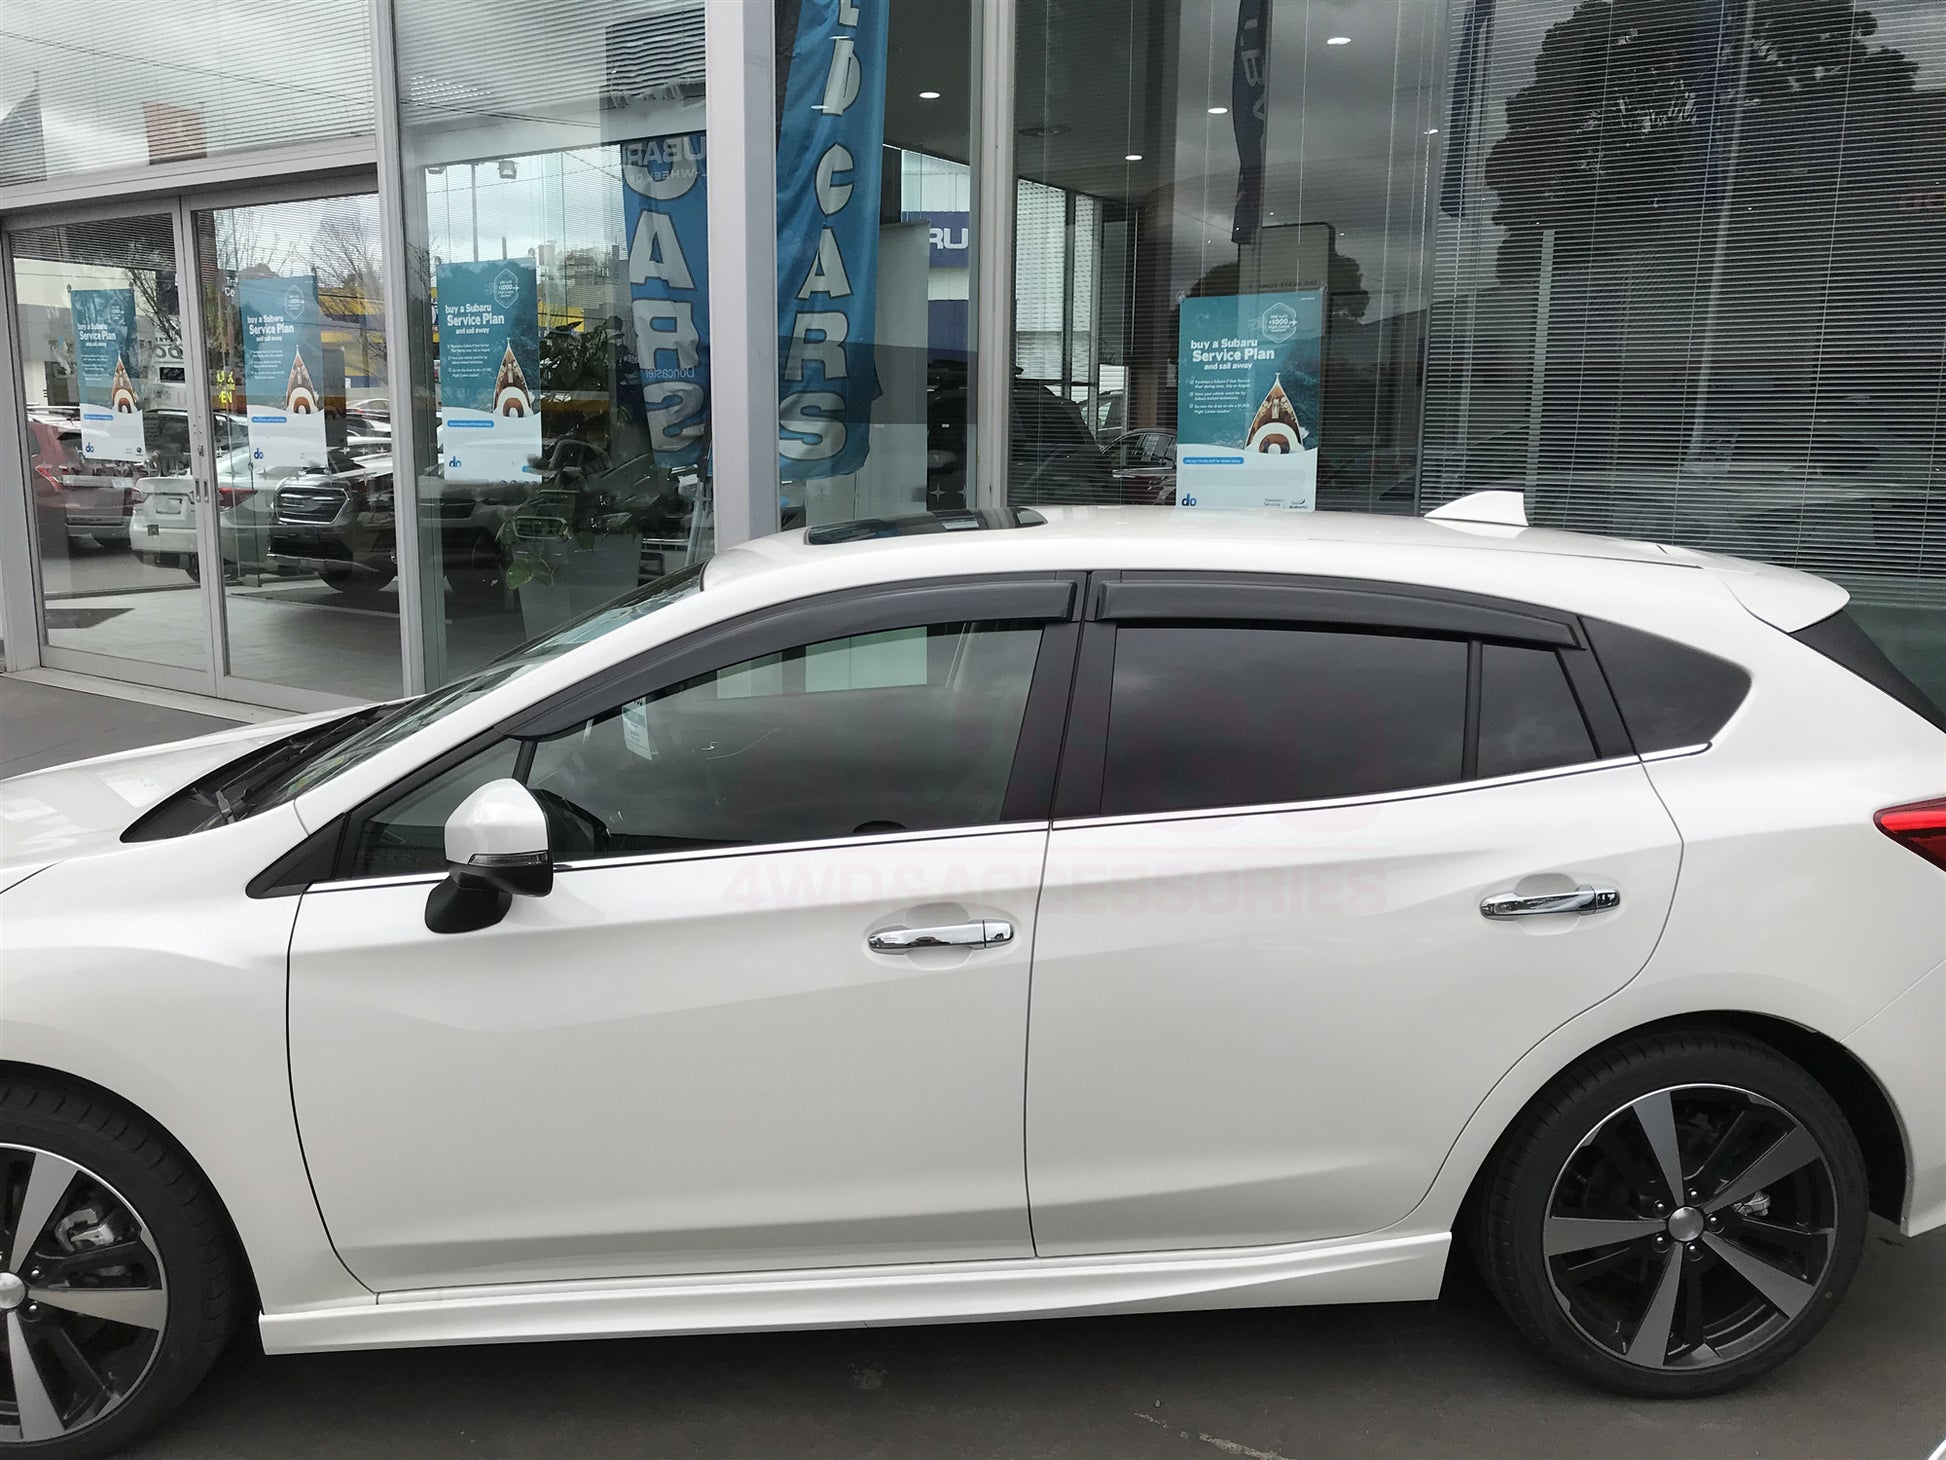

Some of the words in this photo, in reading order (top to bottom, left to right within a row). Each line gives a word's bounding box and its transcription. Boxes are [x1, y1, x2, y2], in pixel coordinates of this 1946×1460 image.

[778, 143, 855, 460] CARS
[445, 305, 458, 314] buy
[466, 304, 492, 312] Subaru
[447, 315, 480, 326] Service
[482, 313, 505, 324] Plan
[79, 331, 101, 340] Service
[102, 331, 116, 340] Plan
[249, 324, 275, 335] Service
[276, 324, 294, 333] Plan
[1191, 340, 1210, 350] buy
[1221, 338, 1258, 348] Subaru
[1192, 350, 1242, 362] Service
[1244, 349, 1275, 360] Plan
[1182, 494, 1197, 506] do
